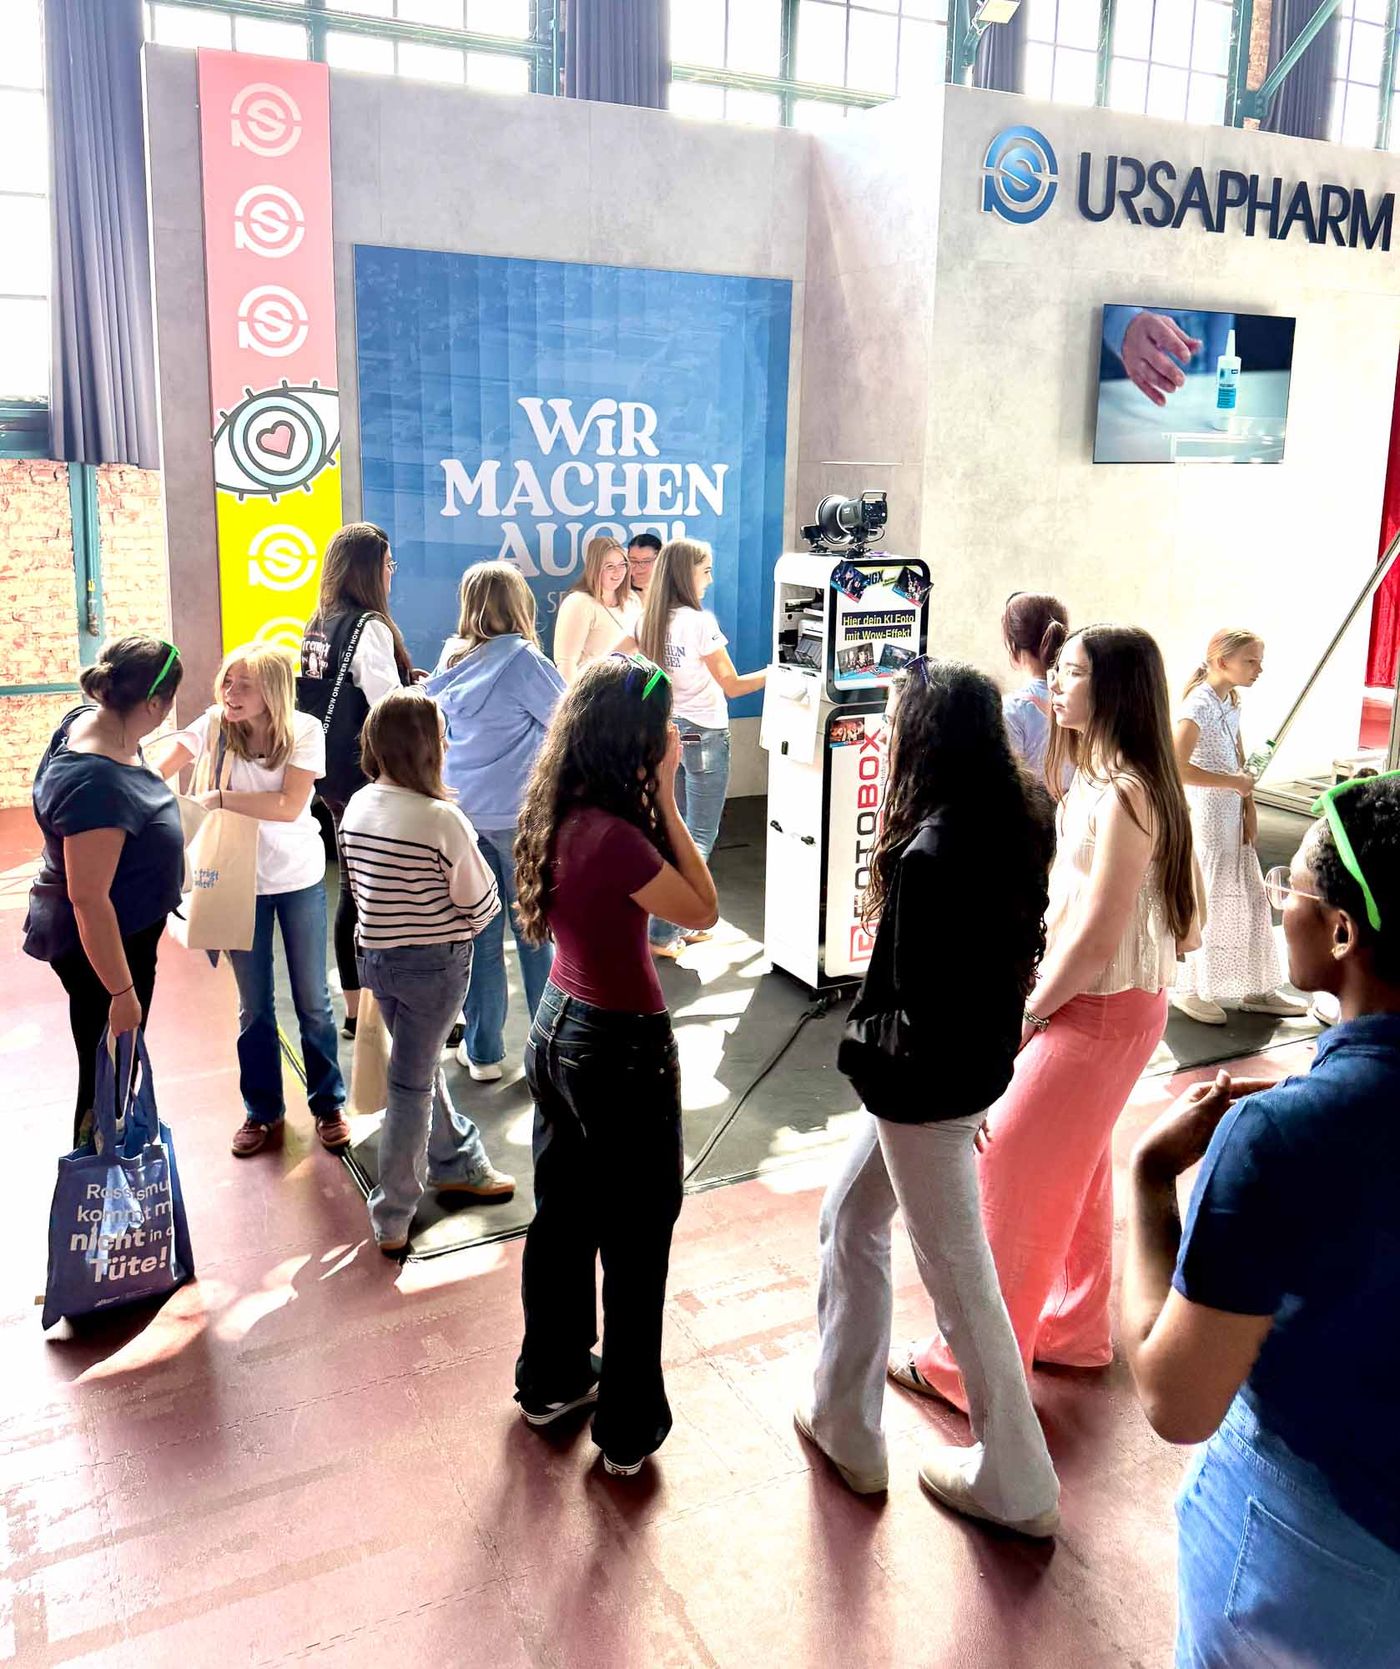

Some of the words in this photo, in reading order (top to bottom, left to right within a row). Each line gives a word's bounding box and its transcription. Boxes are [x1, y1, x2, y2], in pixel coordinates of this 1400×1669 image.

[1078, 151, 1396, 252] URSAPHARM
[440, 459, 730, 517] MACHEN
[843, 616, 862, 626] Hier
[863, 615, 882, 625] dein
[884, 614, 893, 624] KI
[895, 614, 915, 623] Foto
[846, 630, 860, 640] mit
[861, 628, 911, 640] Wow-Effekt
[86, 1179, 170, 1201] Rassismu
[77, 1204, 152, 1222] kommt
[69, 1223, 146, 1252] nicht
[149, 1228, 162, 1242] in
[89, 1246, 168, 1283] Tüte!
